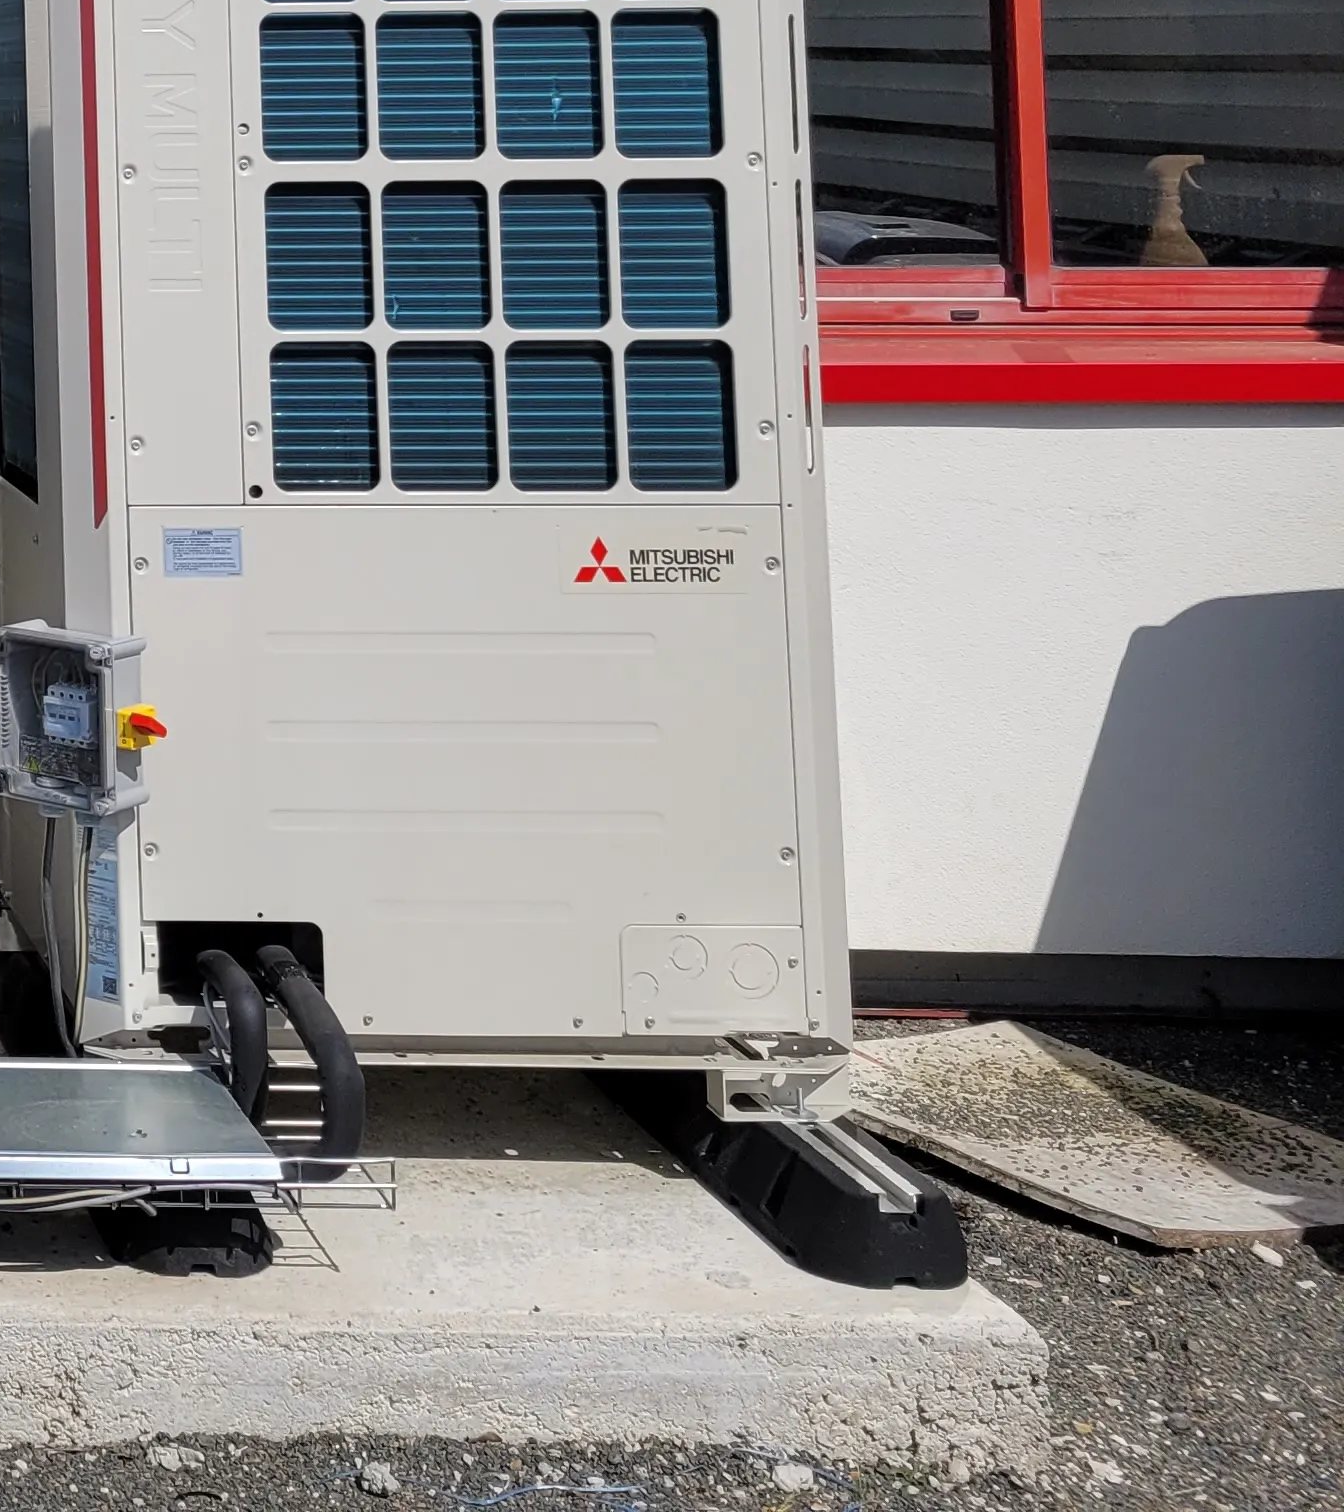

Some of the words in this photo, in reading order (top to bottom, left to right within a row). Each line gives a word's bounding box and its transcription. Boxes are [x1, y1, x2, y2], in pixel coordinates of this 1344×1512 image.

[142, 72, 204, 293] MULTI
[629, 549, 734, 565] MITSUBISHI
[630, 567, 720, 583] ELECTRIC
